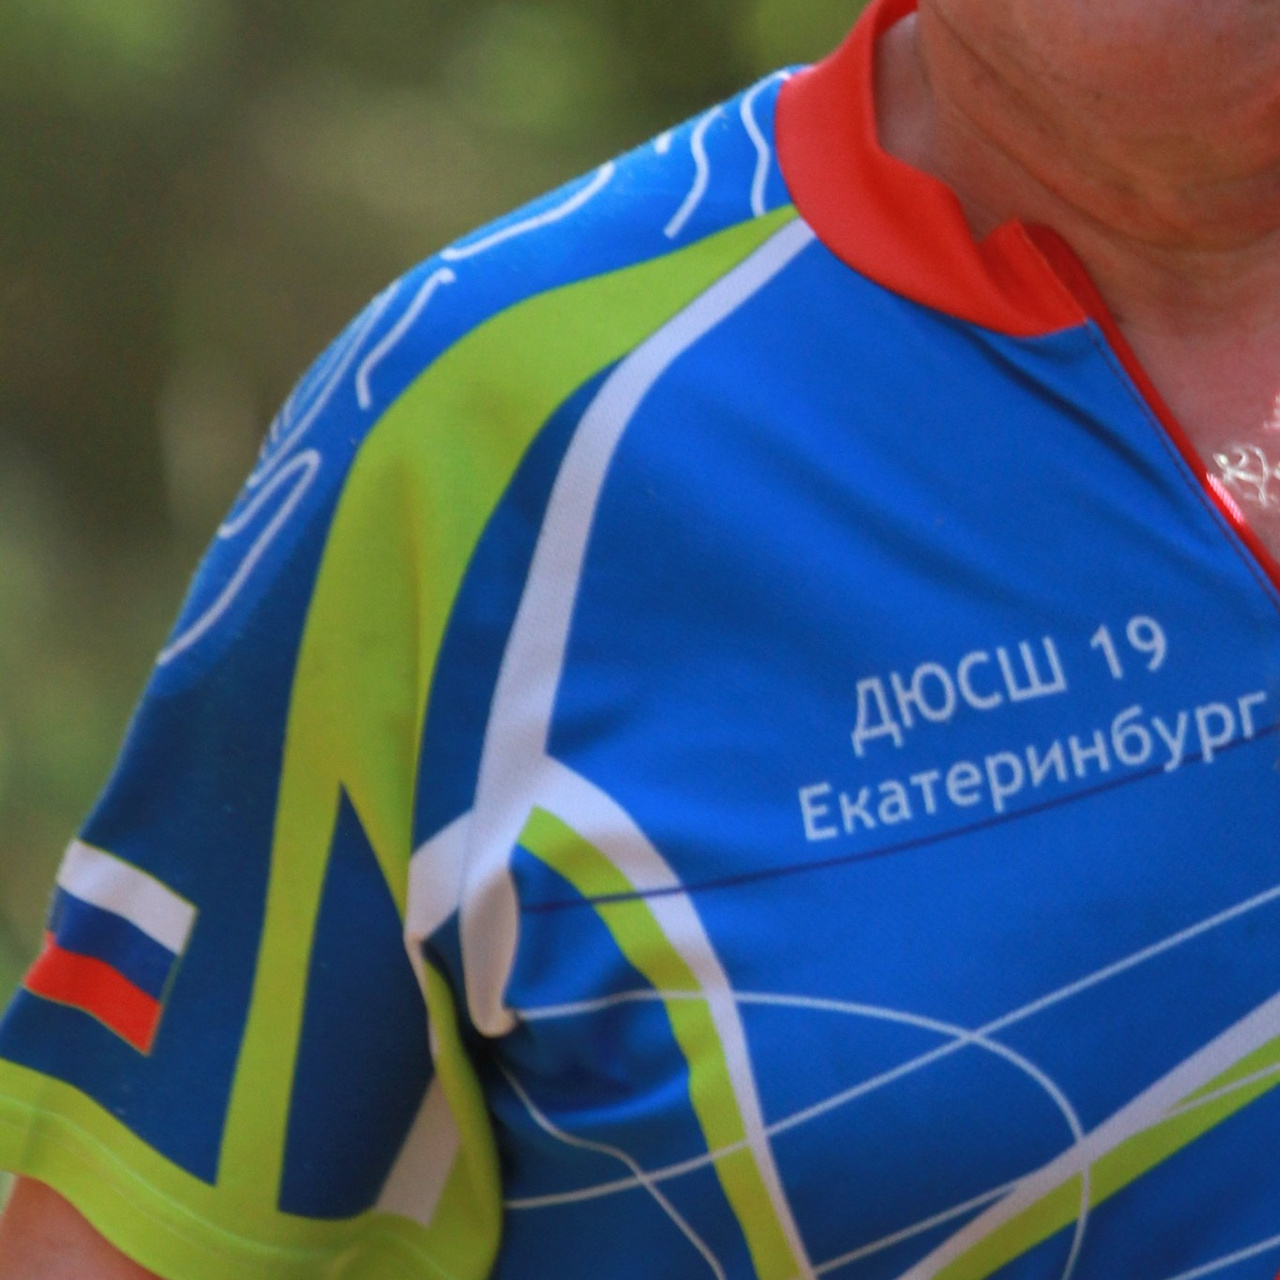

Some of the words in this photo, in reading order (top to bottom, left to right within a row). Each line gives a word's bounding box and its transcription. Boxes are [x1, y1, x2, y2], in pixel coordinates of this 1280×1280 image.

[850, 635, 1068, 757] ДЮСШ
[1090, 615, 1167, 680] 19
[799, 690, 1268, 842] Екатеринбург
